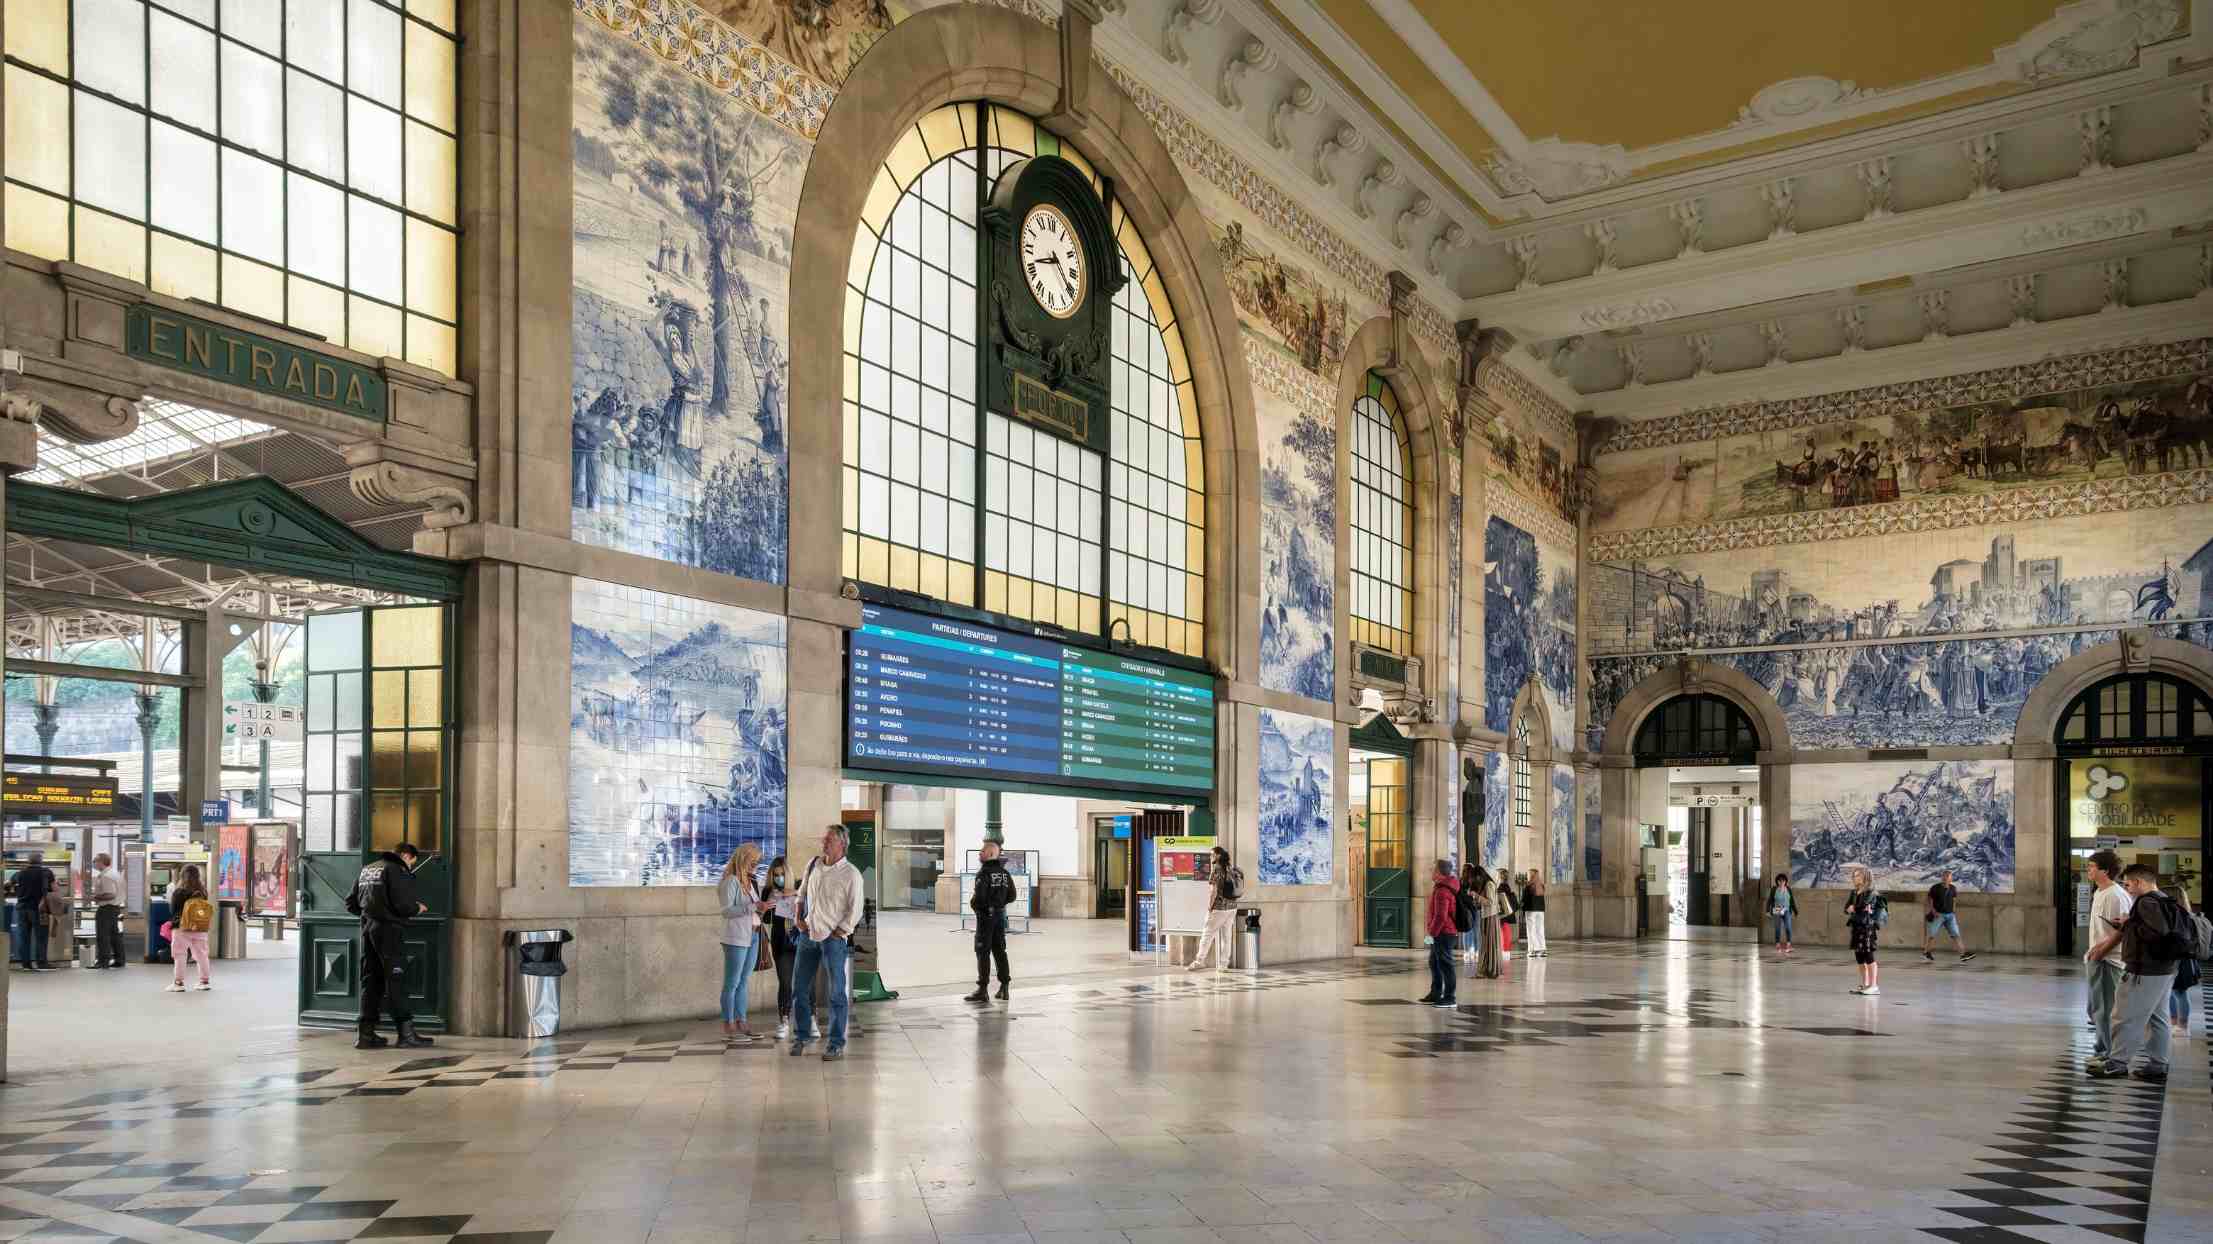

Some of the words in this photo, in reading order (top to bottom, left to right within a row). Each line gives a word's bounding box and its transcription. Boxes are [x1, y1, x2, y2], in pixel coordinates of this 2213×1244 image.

[149, 316, 366, 410] ENTRADA
[265, 711, 272, 720] 2
[247, 727, 254, 737] 3
[263, 726, 272, 736] A
[2079, 802, 2129, 815] CENTRO
[2087, 814, 2177, 827] MOBILIDADE
